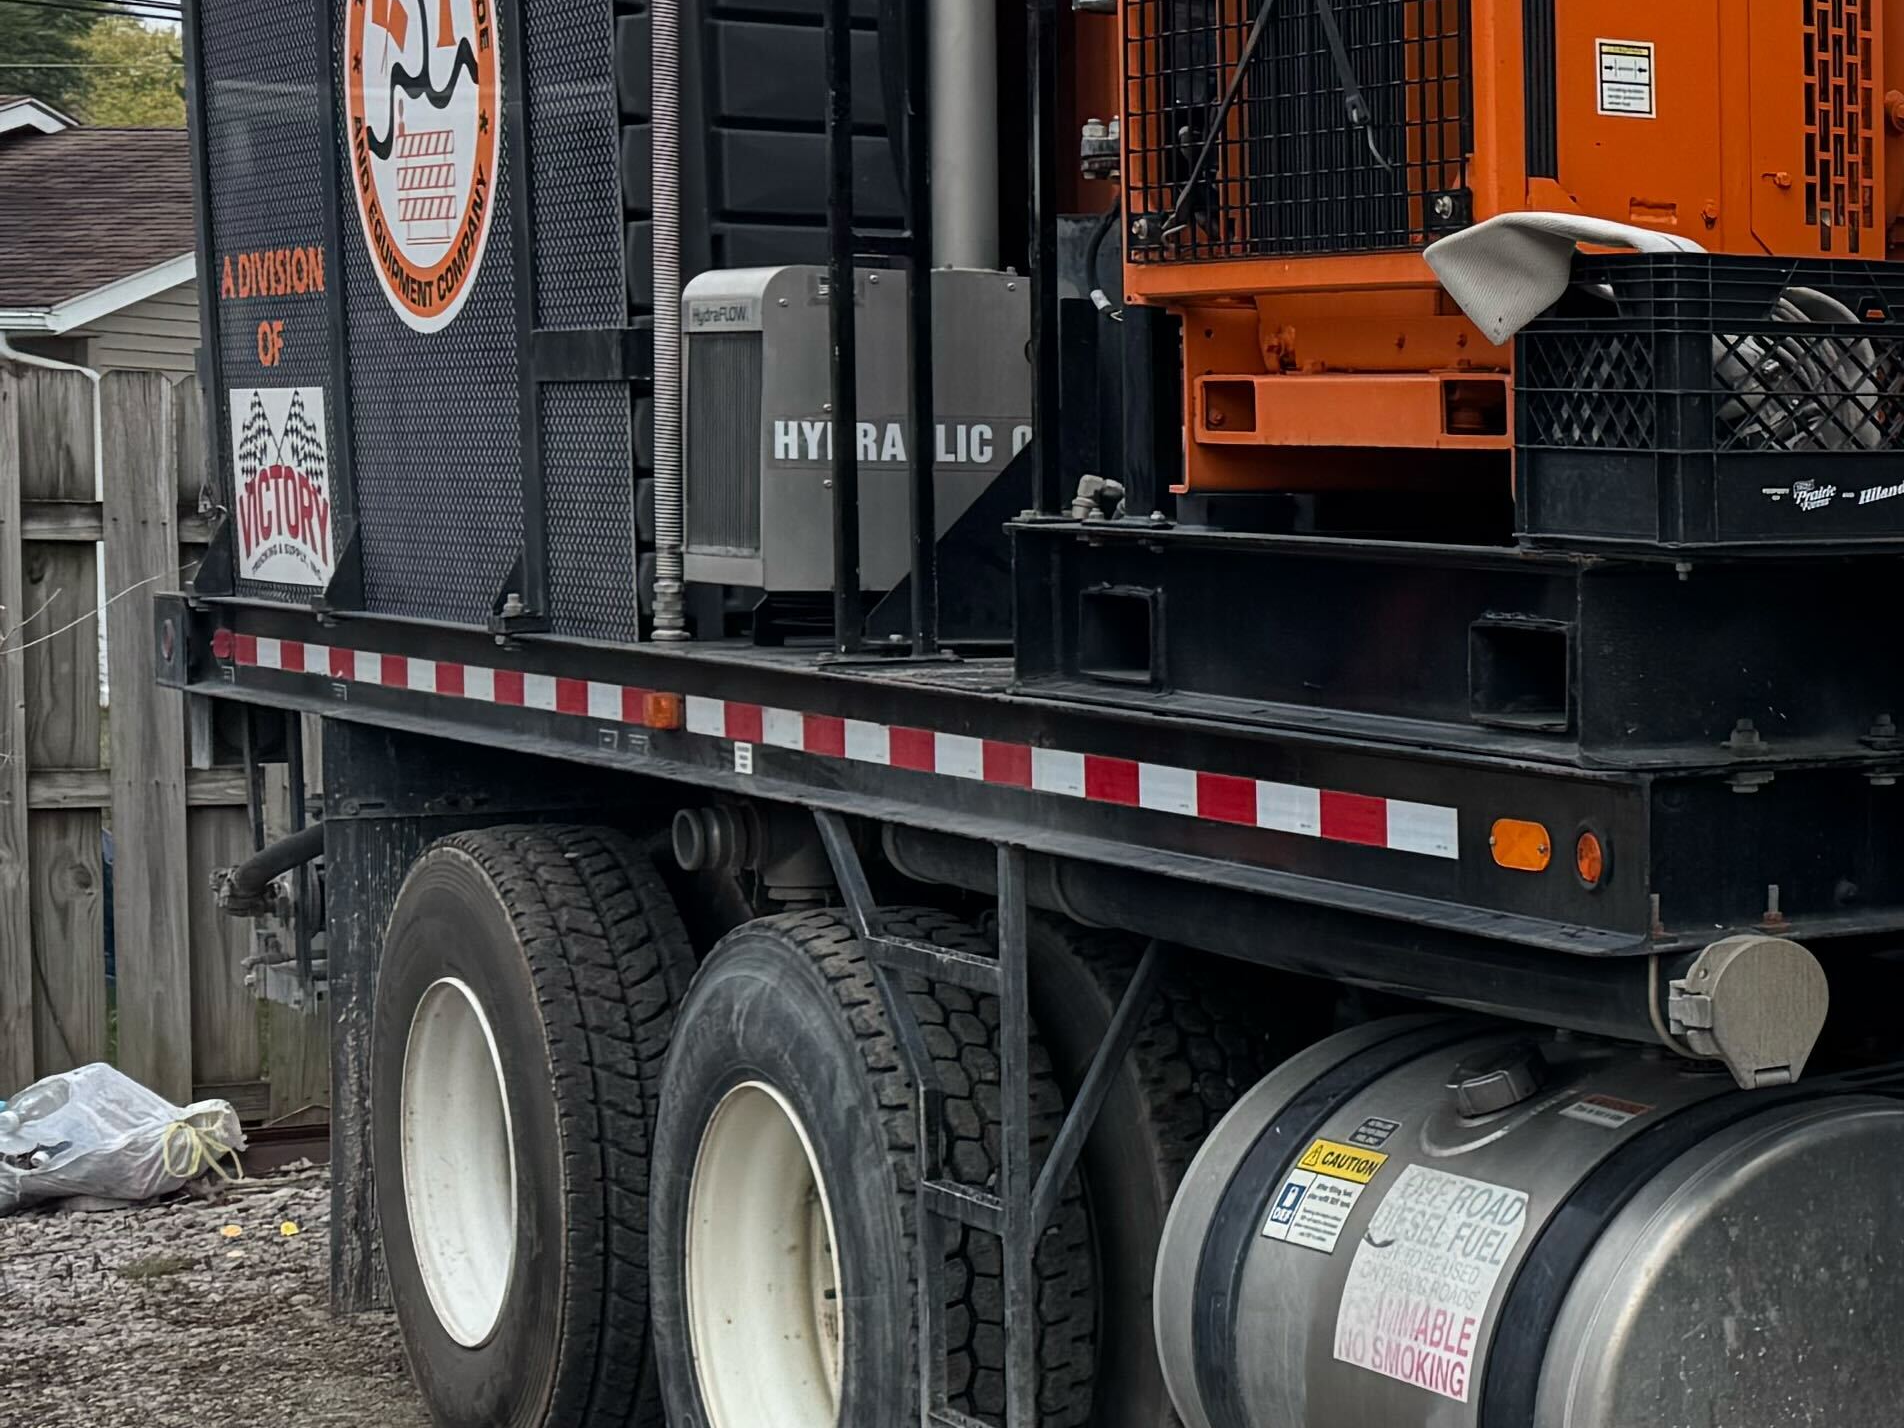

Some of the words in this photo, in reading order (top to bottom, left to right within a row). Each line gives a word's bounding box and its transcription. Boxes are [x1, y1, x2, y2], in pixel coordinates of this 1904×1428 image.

[354, 116, 370, 193] AND
[369, 199, 433, 307] EQUIPMENT
[437, 163, 487, 300] COMPANY
[222, 255, 235, 299] A
[238, 246, 325, 298] DIVISION
[258, 320, 284, 367] OF
[774, 420, 993, 463] HYRALIC
[239, 464, 329, 567] VICTORY
[1322, 1151, 1379, 1176] CAUTION
[1448, 1184, 1527, 1226] ROAD
[1447, 1221, 1508, 1266] FUEL
[1338, 1323, 1366, 1363] NO
[1371, 1335, 1465, 1398] SMOKING
